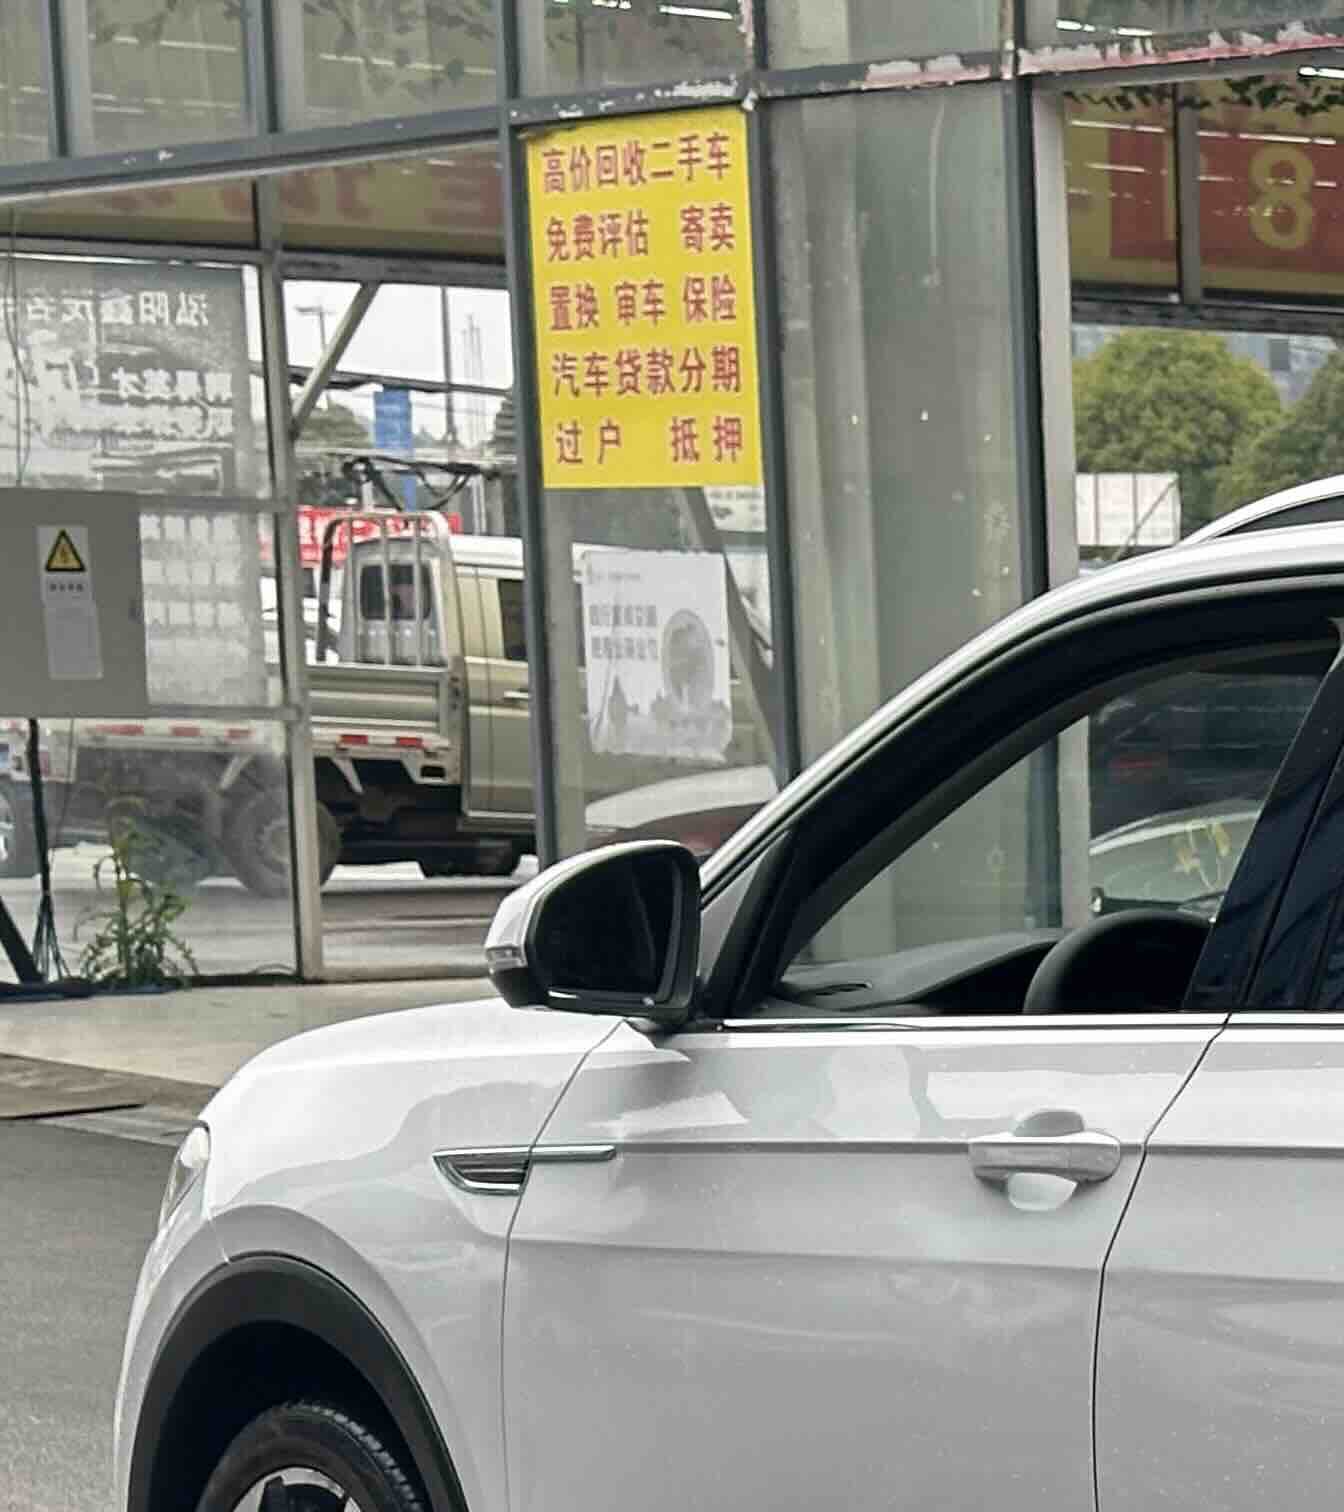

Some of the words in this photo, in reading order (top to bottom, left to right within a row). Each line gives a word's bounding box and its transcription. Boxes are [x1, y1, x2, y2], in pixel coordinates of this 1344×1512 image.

[543, 131, 731, 193] 高价回收二手车
[546, 209, 649, 262] 免费评估
[681, 202, 735, 253] 寄卖
[550, 283, 600, 331] 置换
[615, 279, 665, 326] 审车
[683, 273, 737, 323] 保险
[552, 345, 741, 398] 汽车贷款分期
[556, 416, 622, 464] 过户
[671, 415, 743, 464] 抵押
